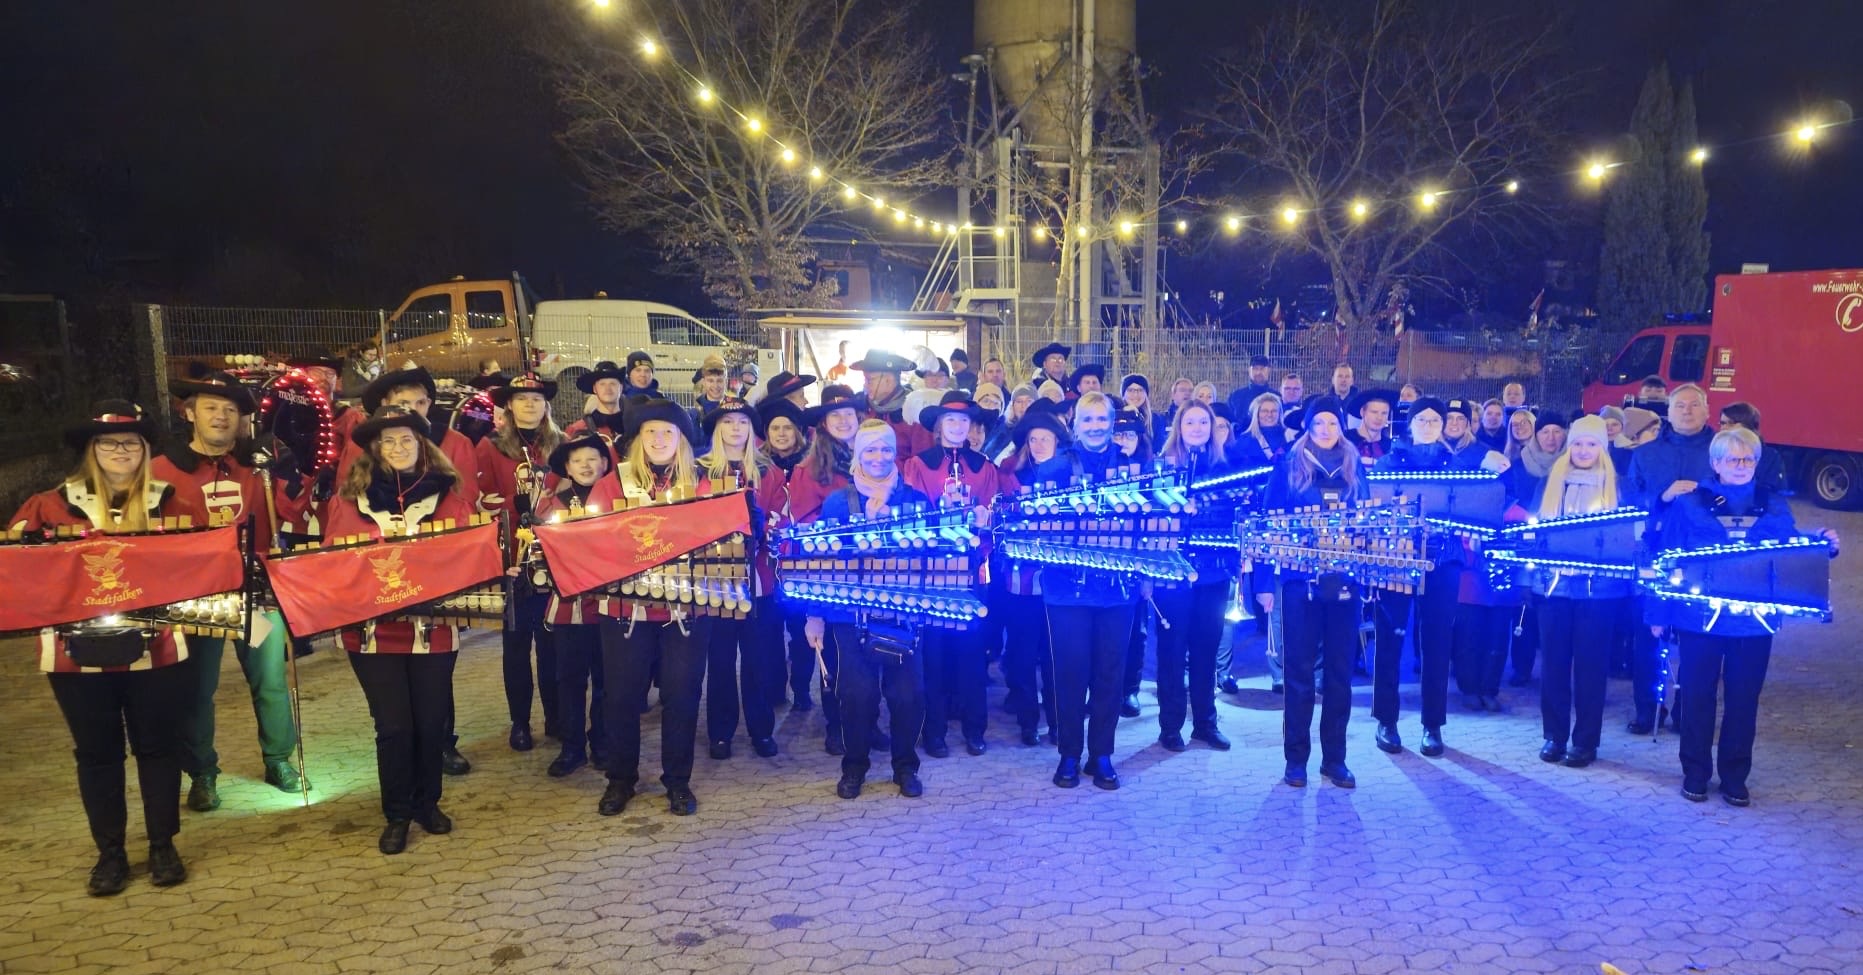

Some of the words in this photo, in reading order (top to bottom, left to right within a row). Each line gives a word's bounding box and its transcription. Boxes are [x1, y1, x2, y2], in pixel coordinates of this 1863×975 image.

[278, 388, 309, 406] majestic
[632, 542, 675, 563] Stadtfalken
[82, 587, 143, 606] Stadtfalken
[374, 584, 423, 605] Stadtfalken
